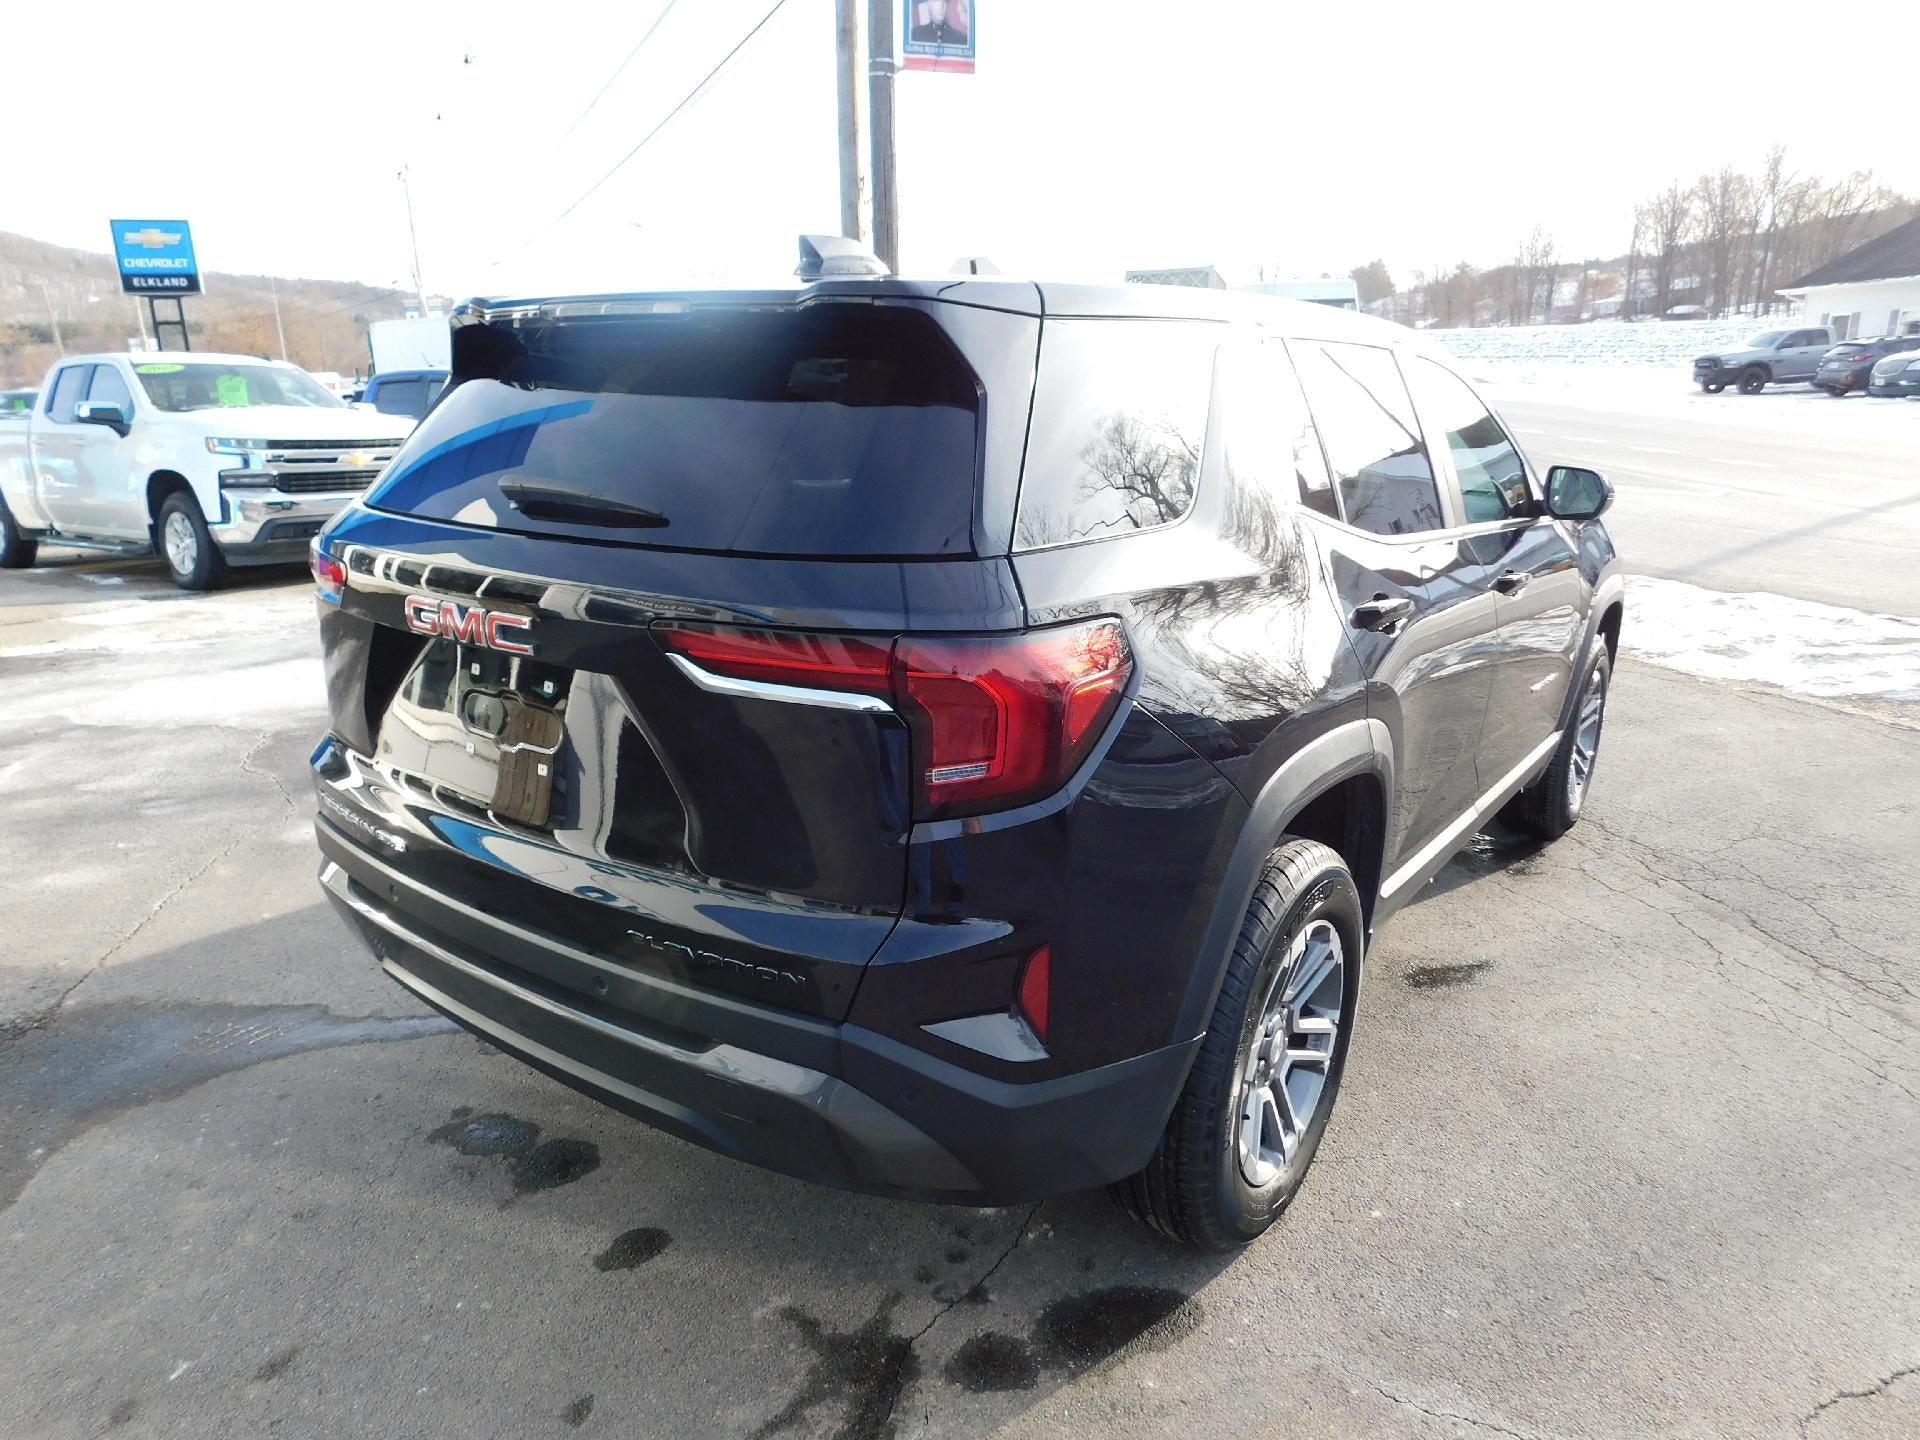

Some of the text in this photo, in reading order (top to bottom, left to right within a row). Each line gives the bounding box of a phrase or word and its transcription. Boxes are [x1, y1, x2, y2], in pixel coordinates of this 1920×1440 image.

[124, 258, 189, 268] CHEVROLET
[132, 277, 188, 287] ELKLAND
[404, 594, 534, 656] GMC
